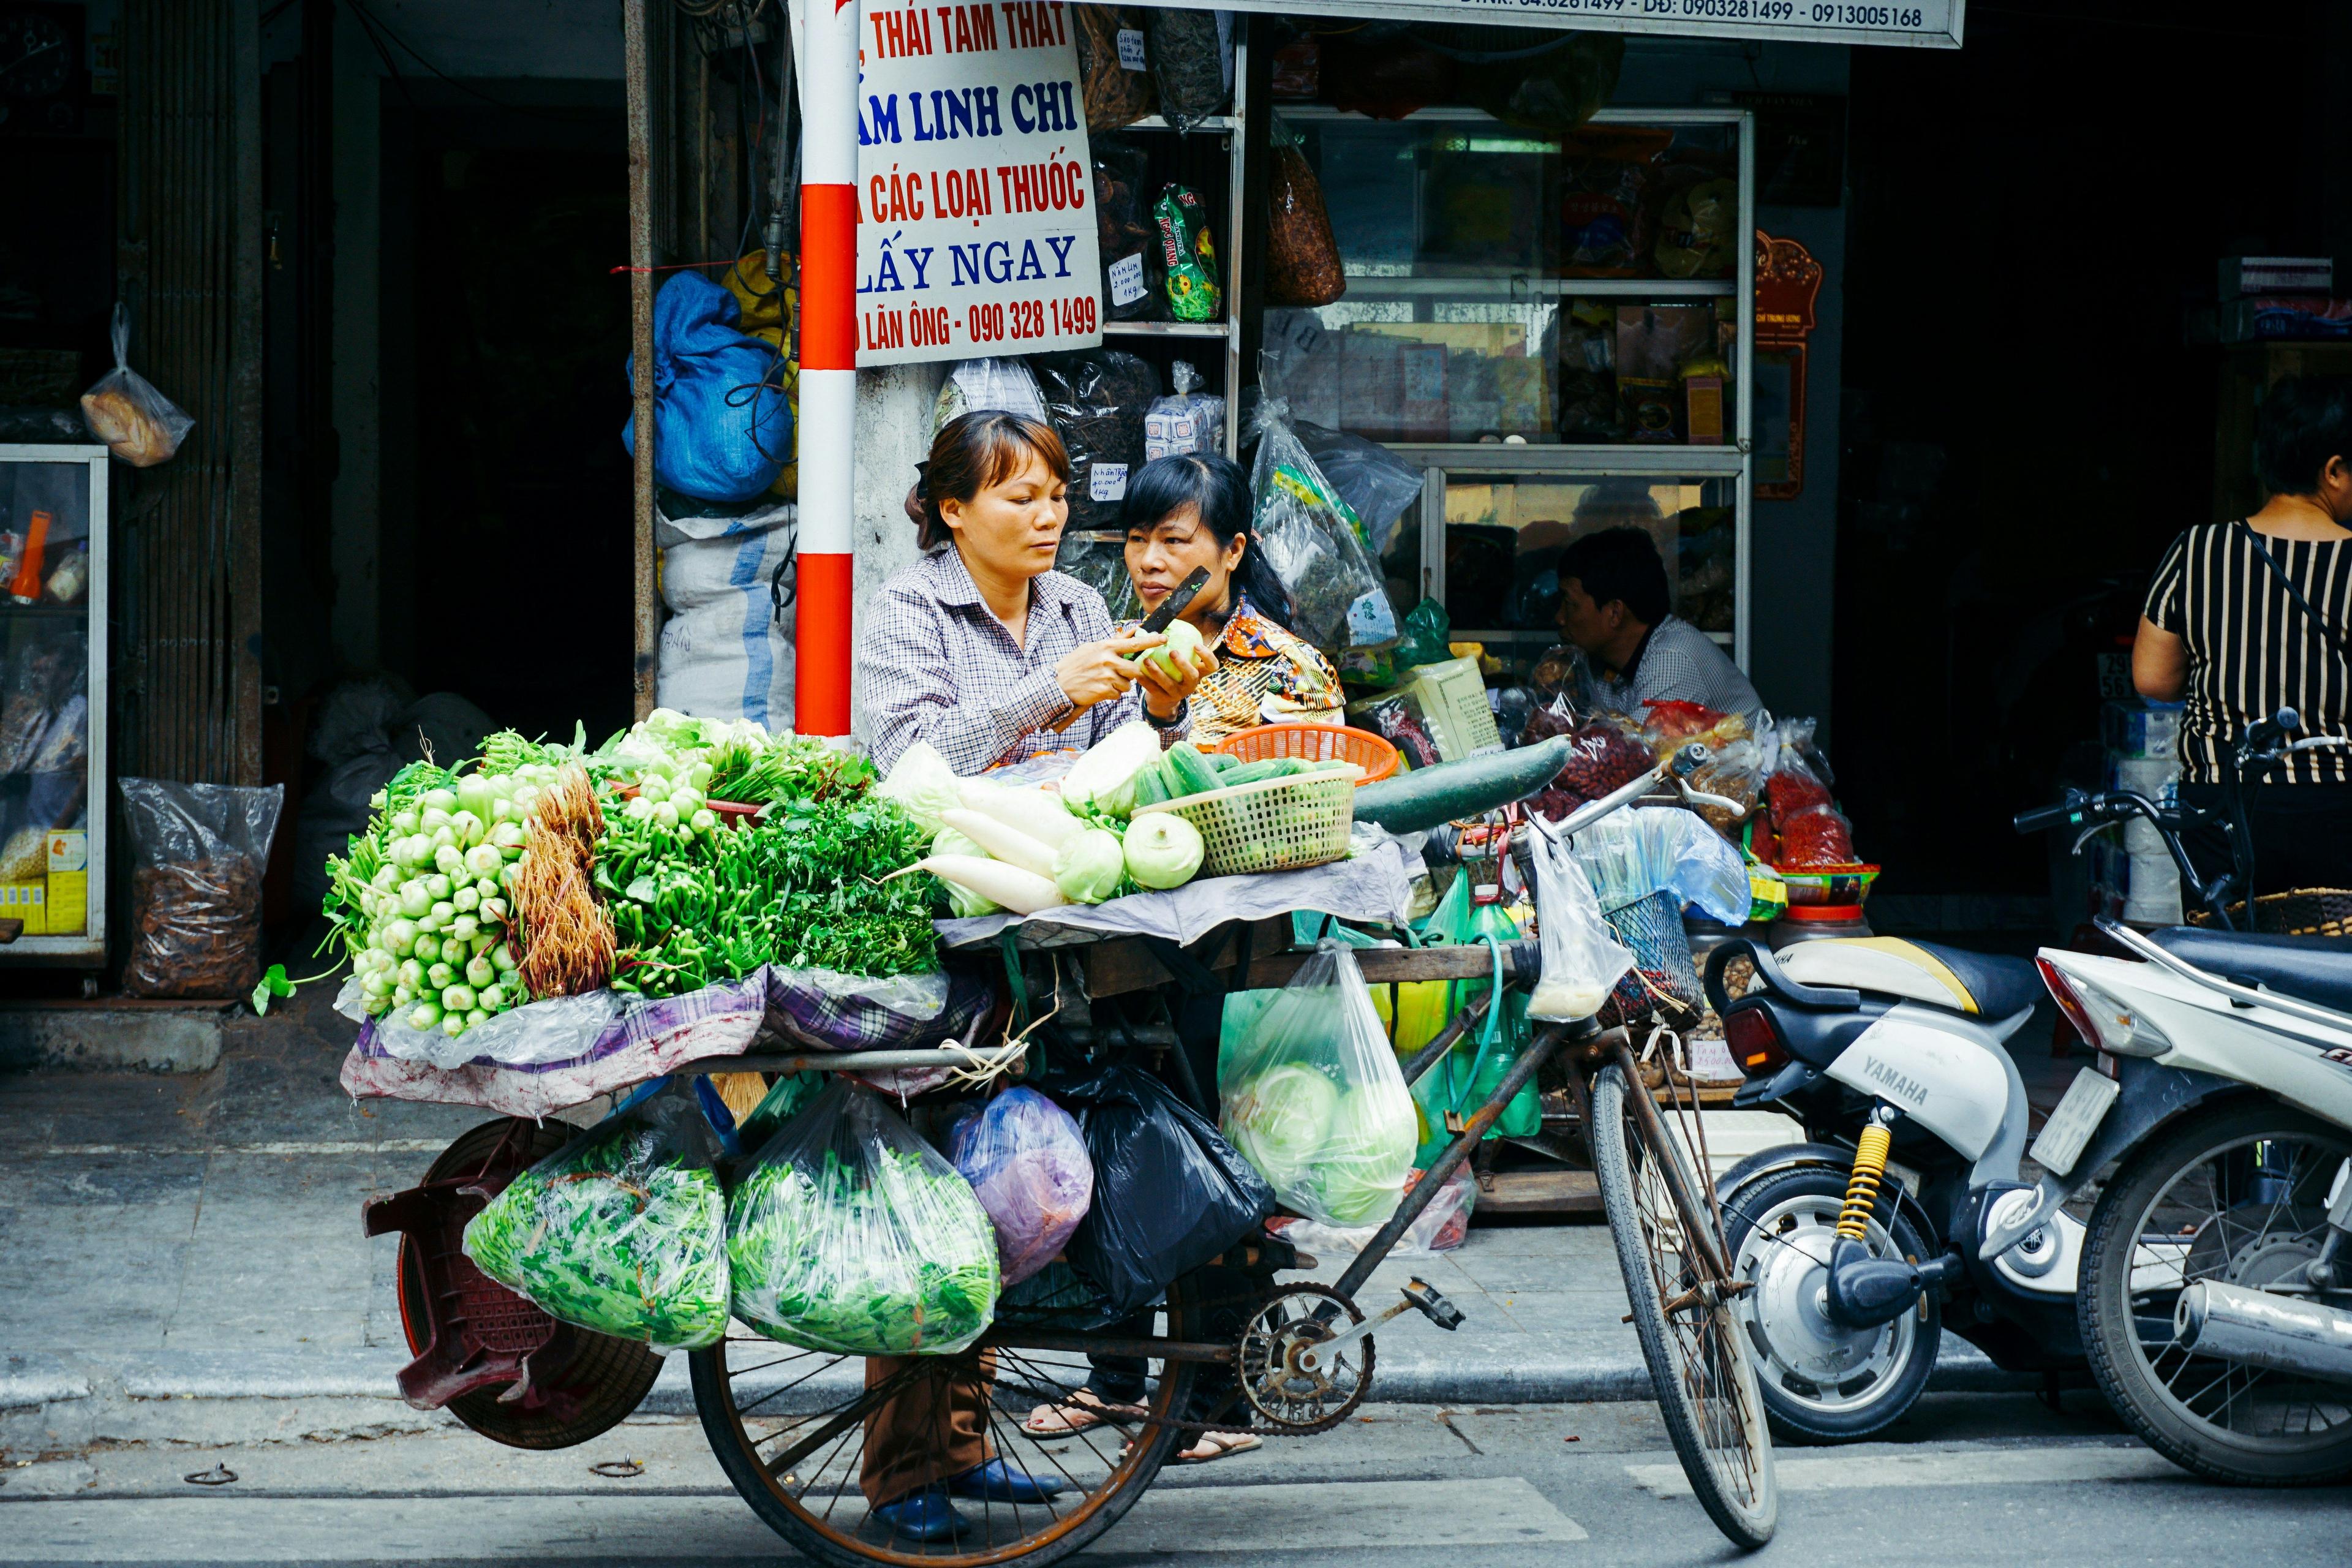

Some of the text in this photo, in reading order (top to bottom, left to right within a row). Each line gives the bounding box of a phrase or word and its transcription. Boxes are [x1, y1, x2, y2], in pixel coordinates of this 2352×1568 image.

[937, 4, 998, 53] TAM
[1683, 0, 1793, 20] 0903281499
[1812, 4, 1922, 26] 0913005168
[909, 86, 1003, 141] LINH
[1011, 81, 1077, 134] CHI
[870, 163, 924, 223] CÁC
[930, 168, 992, 227] LOẠI
[997, 146, 1085, 214] THUỐC
[948, 235, 1076, 287] NGAY
[1163, 238, 1179, 267] QUANG
[1114, 271, 1141, 289] 2.000.000
[865, 303, 904, 351] LÃN
[909, 300, 950, 347] ÔNG
[969, 303, 1004, 342] 090
[1009, 300, 1045, 339] 328
[1050, 296, 1096, 336] 1499
[1863, 1055, 1928, 1106] YAMAHA
